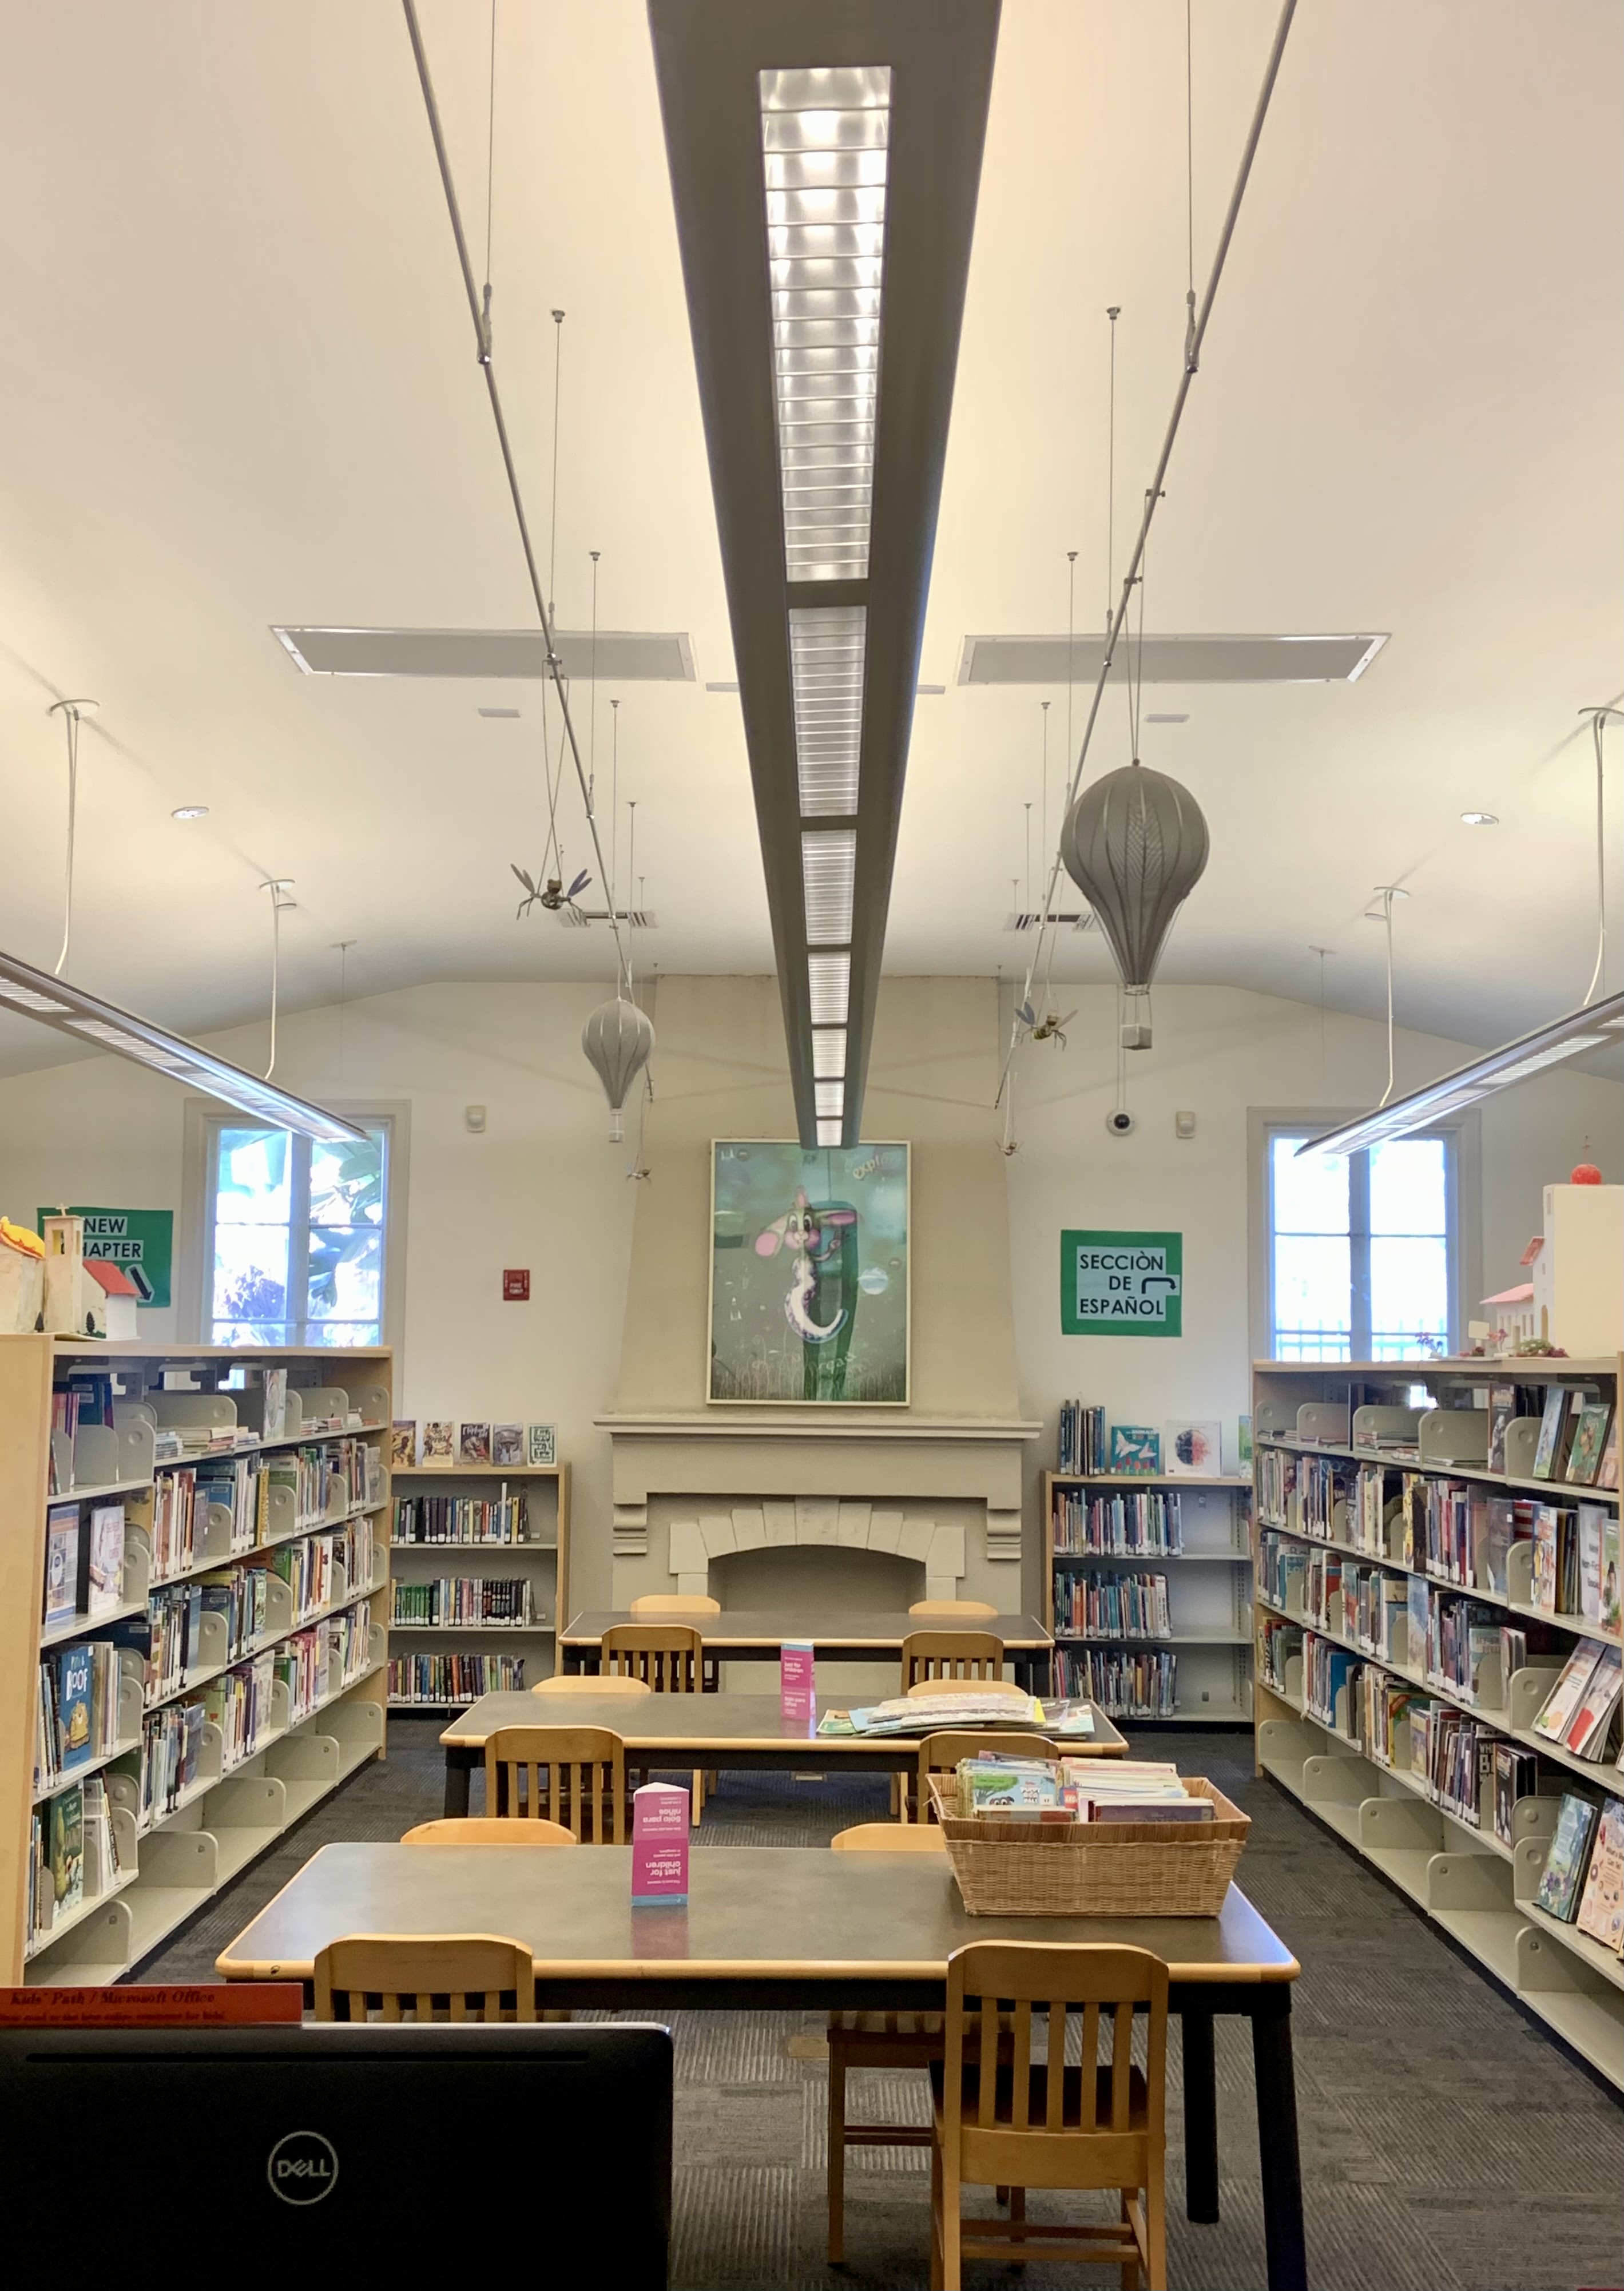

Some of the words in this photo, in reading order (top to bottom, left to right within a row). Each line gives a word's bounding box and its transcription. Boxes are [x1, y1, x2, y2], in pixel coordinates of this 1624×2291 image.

[84, 1218, 125, 1233] NEW
[1109, 1276, 1131, 1291] DE
[1080, 1296, 1164, 1315] ESPAÑOL
[650, 1869, 662, 1877] for
[665, 1867, 681, 1877] just
[172, 1989, 215, 2003] Office
[278, 2158, 331, 2178] DELL
